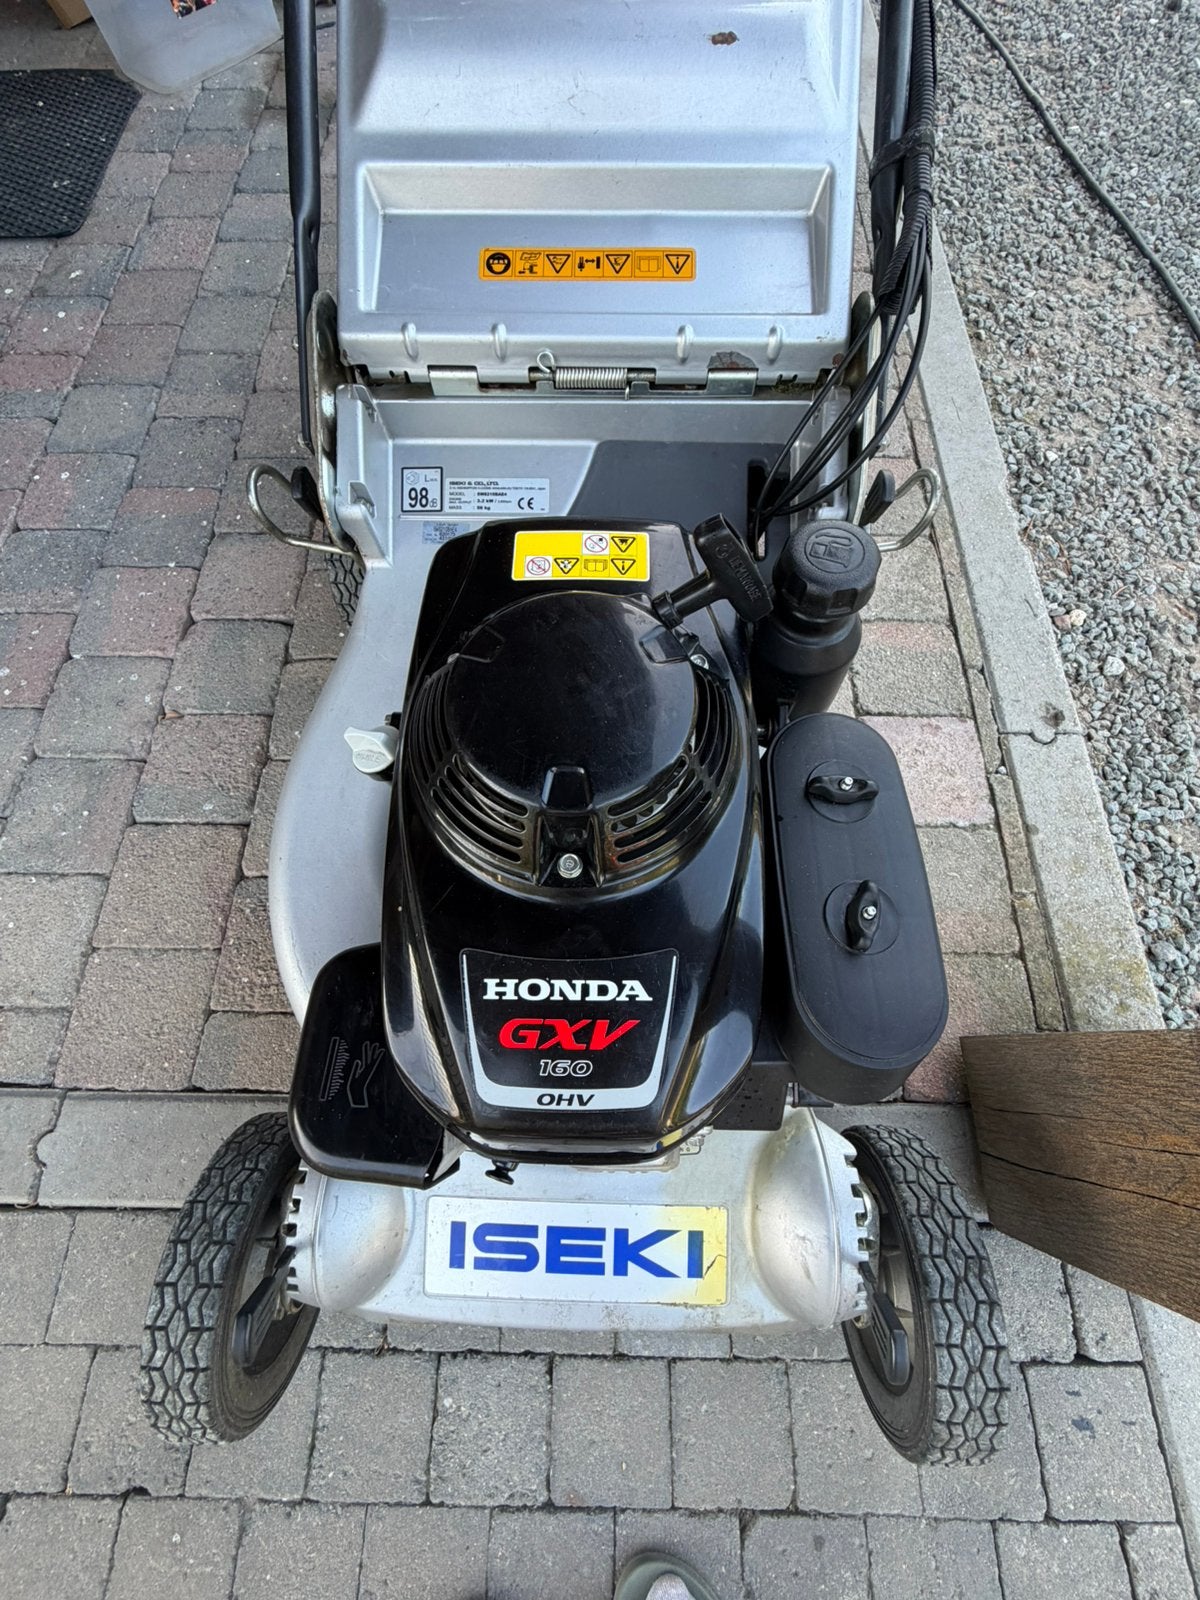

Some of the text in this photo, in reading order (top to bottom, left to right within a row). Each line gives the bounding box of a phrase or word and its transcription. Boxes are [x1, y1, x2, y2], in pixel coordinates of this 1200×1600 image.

[408, 486, 438, 508] 98 dB
[517, 497, 534, 510] CE
[482, 978, 653, 1002] HONDA
[498, 1018, 641, 1051] GXV
[539, 1059, 593, 1077] 160
[536, 1093, 596, 1107] OHV
[449, 1220, 704, 1279] ISEKI
